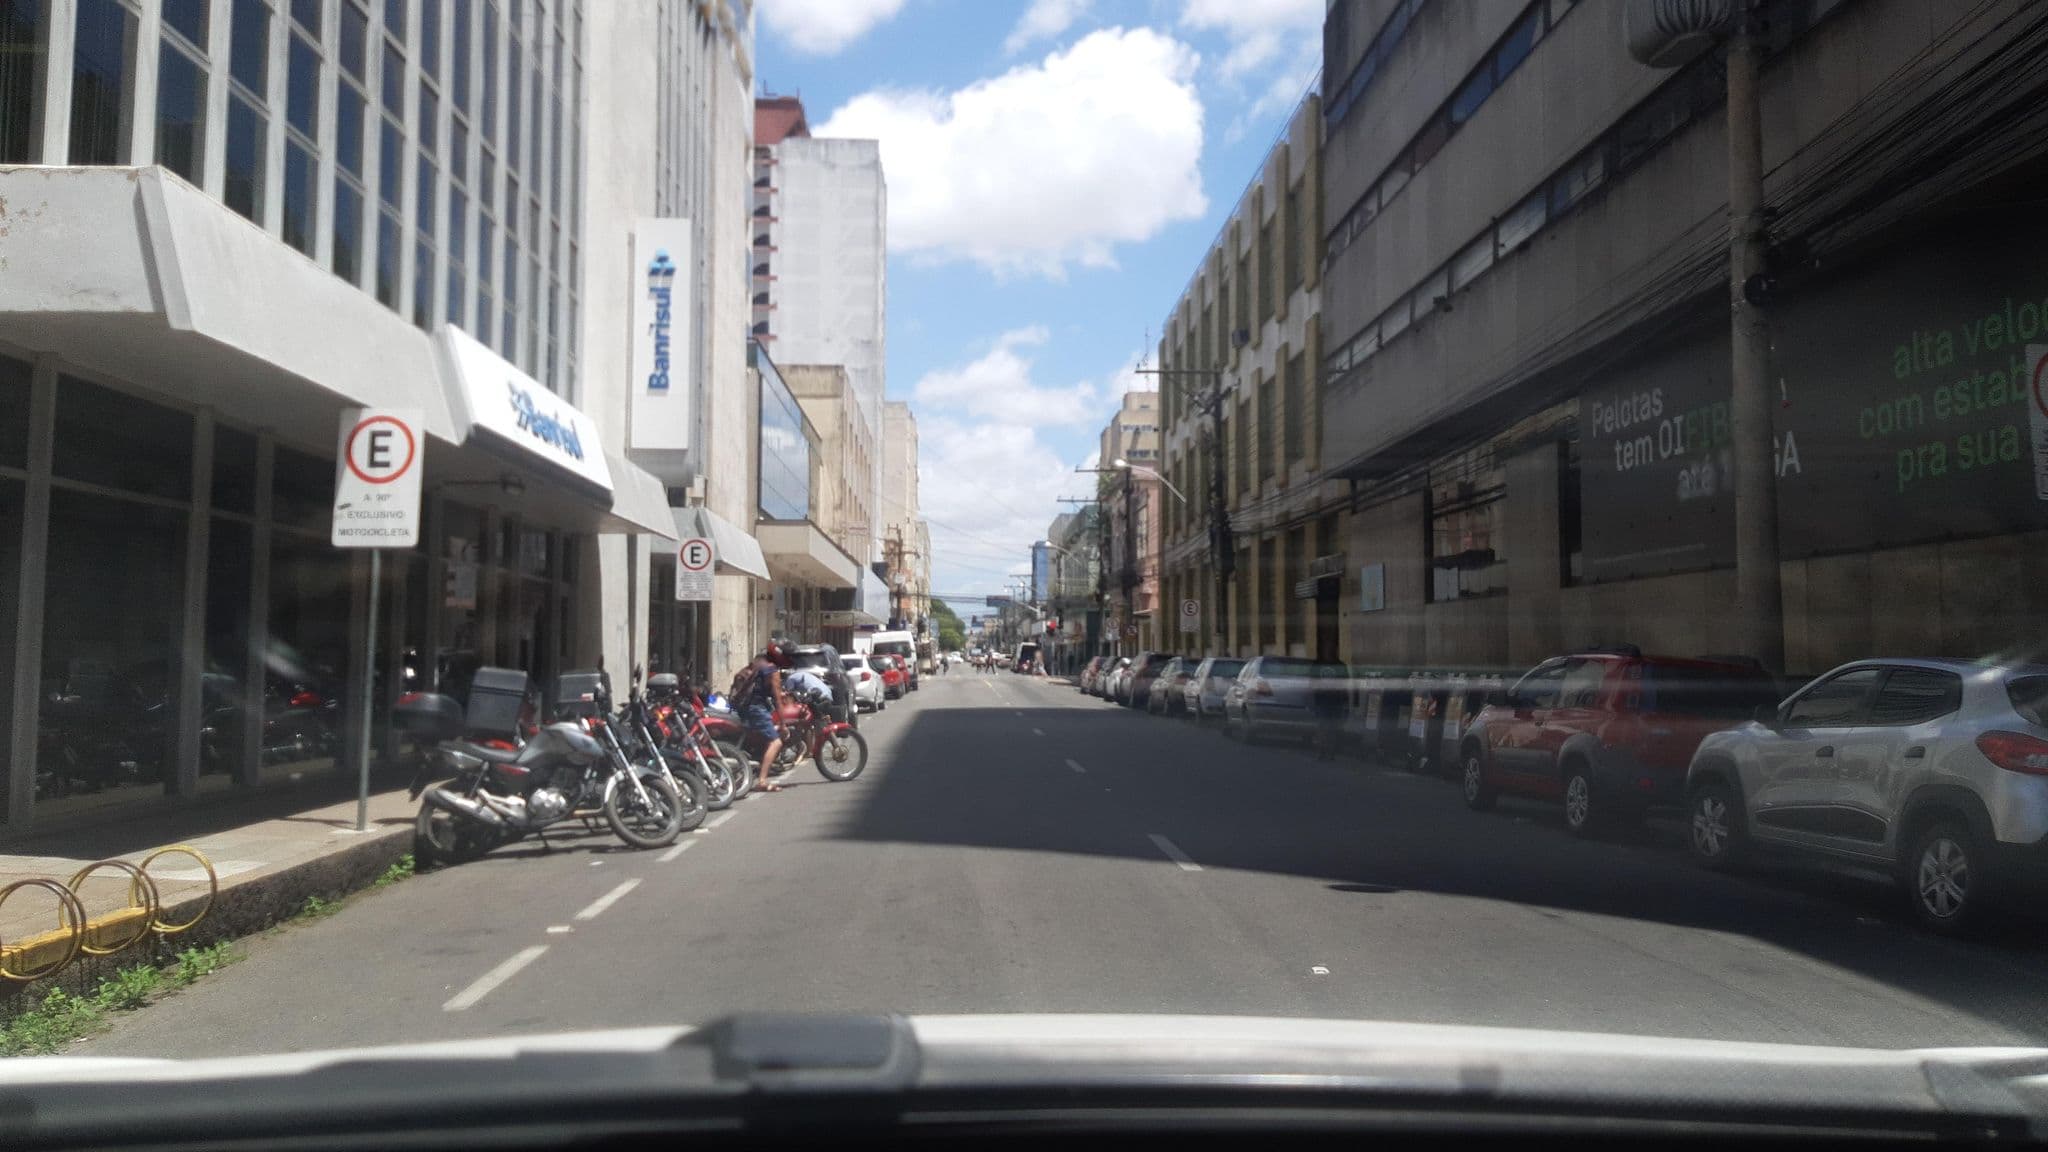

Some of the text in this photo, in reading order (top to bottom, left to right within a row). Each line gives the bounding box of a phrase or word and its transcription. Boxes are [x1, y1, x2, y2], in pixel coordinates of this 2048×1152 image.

[647, 286, 671, 390] Banrisul
[1894, 329, 1954, 379] alta
[1591, 387, 1664, 439] Pelotas
[1860, 354, 2027, 441] com estab
[368, 430, 392, 468] E
[1614, 434, 1654, 472] tem
[1897, 440, 1949, 498] pra
[1958, 424, 2019, 472] sua
[337, 528, 410, 537] MOTOCICLETA
[346, 510, 405, 520] EXCLUSIVO
[691, 546, 702, 564] E
[1187, 603, 1193, 613] E
